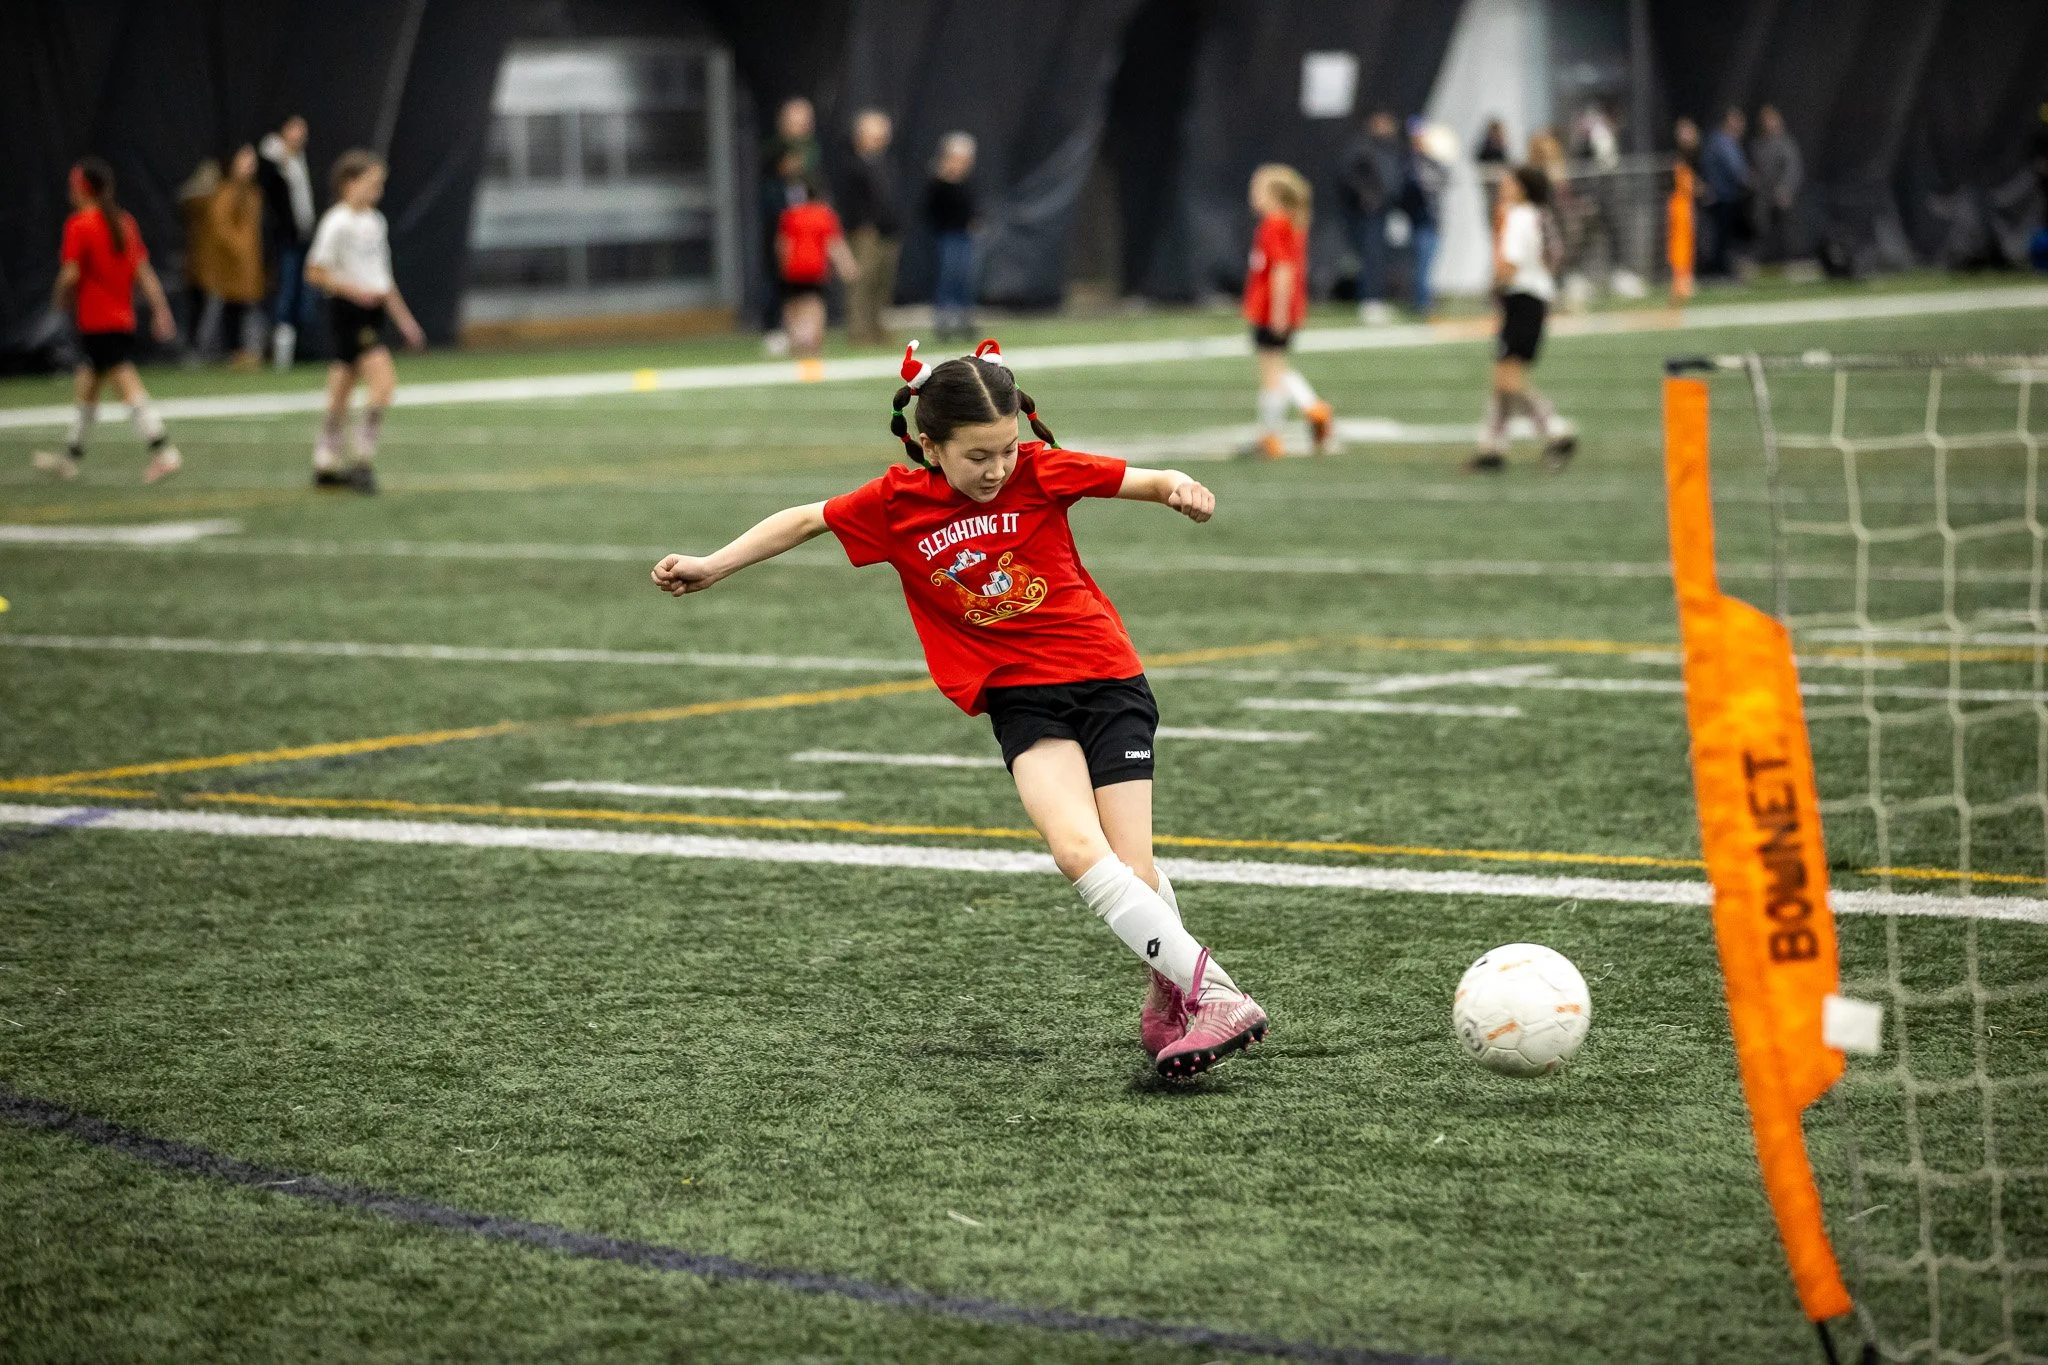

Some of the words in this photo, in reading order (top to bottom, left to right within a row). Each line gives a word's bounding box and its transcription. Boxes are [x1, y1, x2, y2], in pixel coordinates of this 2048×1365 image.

[918, 514, 998, 561] SLEIGHING
[1001, 512, 1020, 533] IT
[1743, 750, 1820, 963] BOWNET
